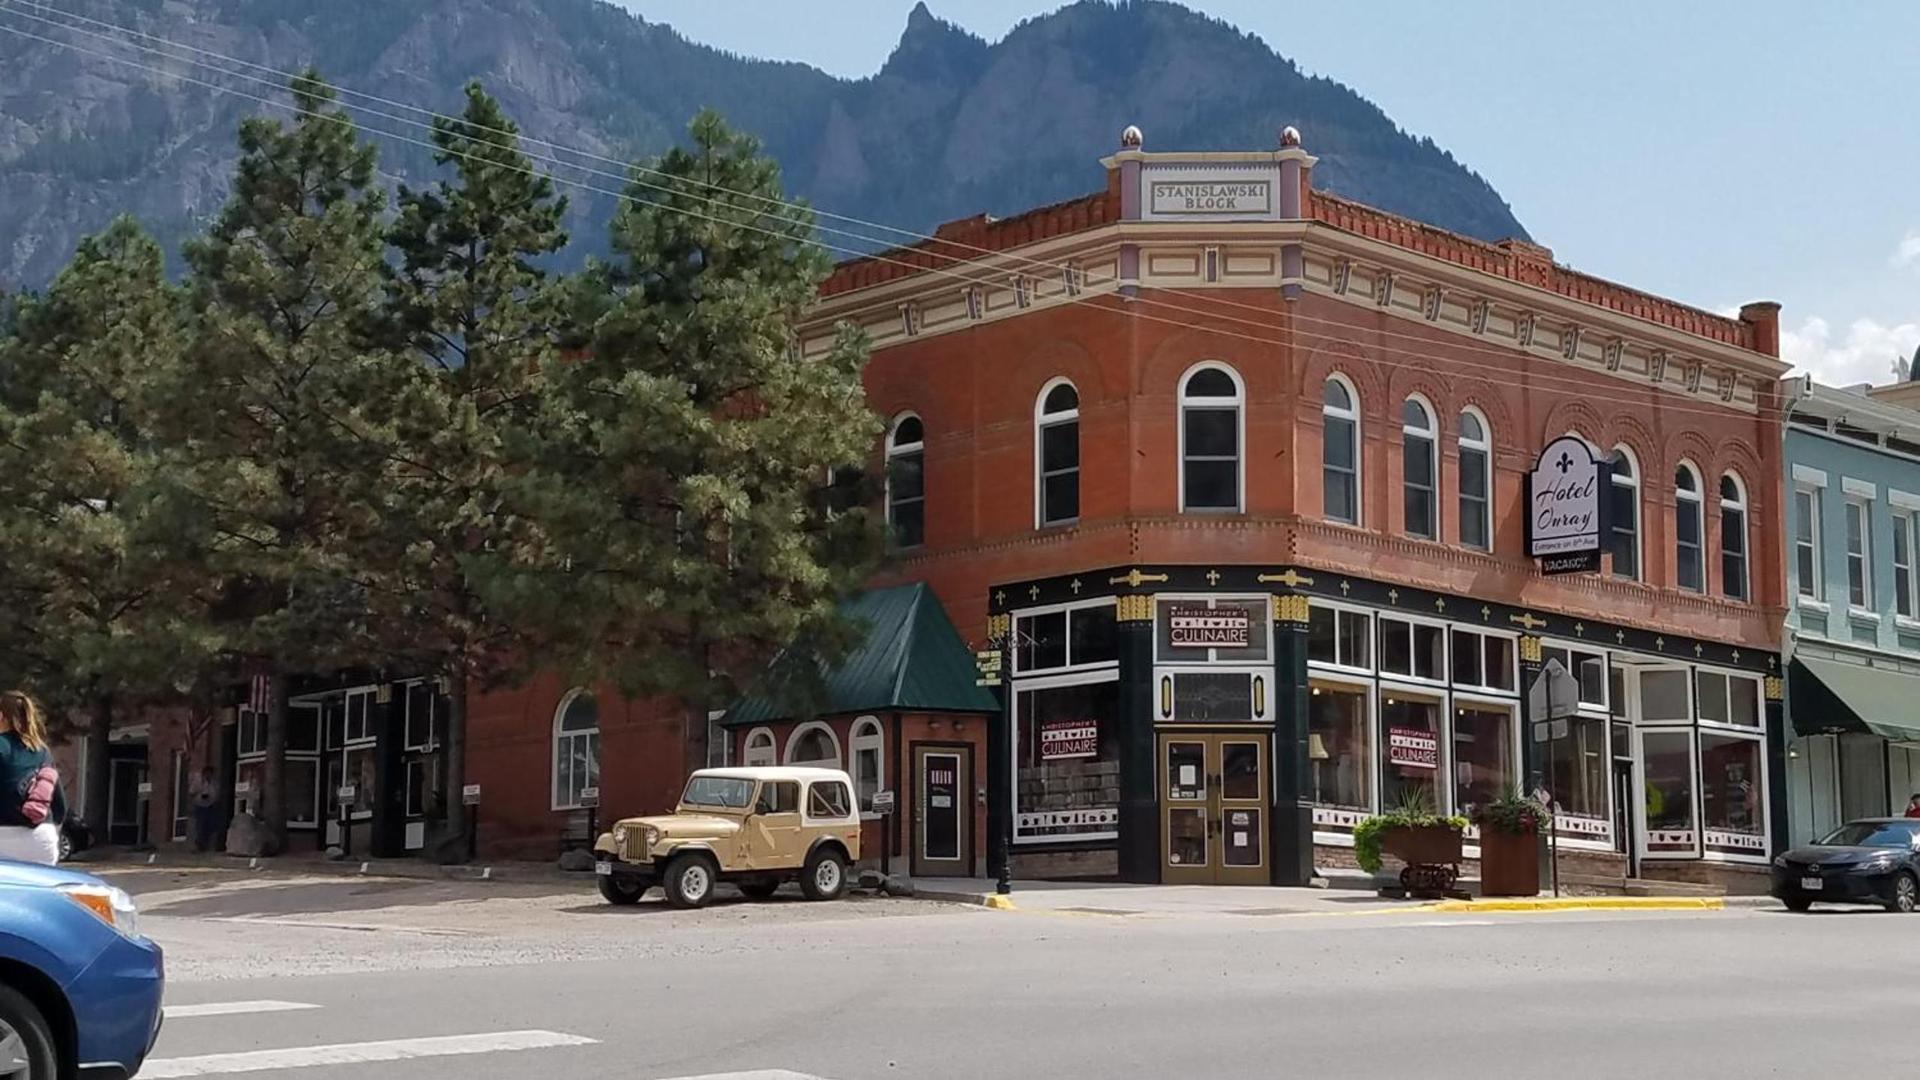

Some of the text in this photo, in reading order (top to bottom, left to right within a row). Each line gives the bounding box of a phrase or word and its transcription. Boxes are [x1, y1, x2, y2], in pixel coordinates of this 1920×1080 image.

[1156, 185, 1265, 198] STANISLAWSKI
[1185, 198, 1236, 209] BLOCK
[1536, 475, 1595, 506] Hotel
[1537, 507, 1592, 532] Ouray
[1171, 629, 1248, 642] CULINAIRE
[1041, 738, 1097, 755] CULINAIRE
[1390, 746, 1437, 764] CULINAIRE
